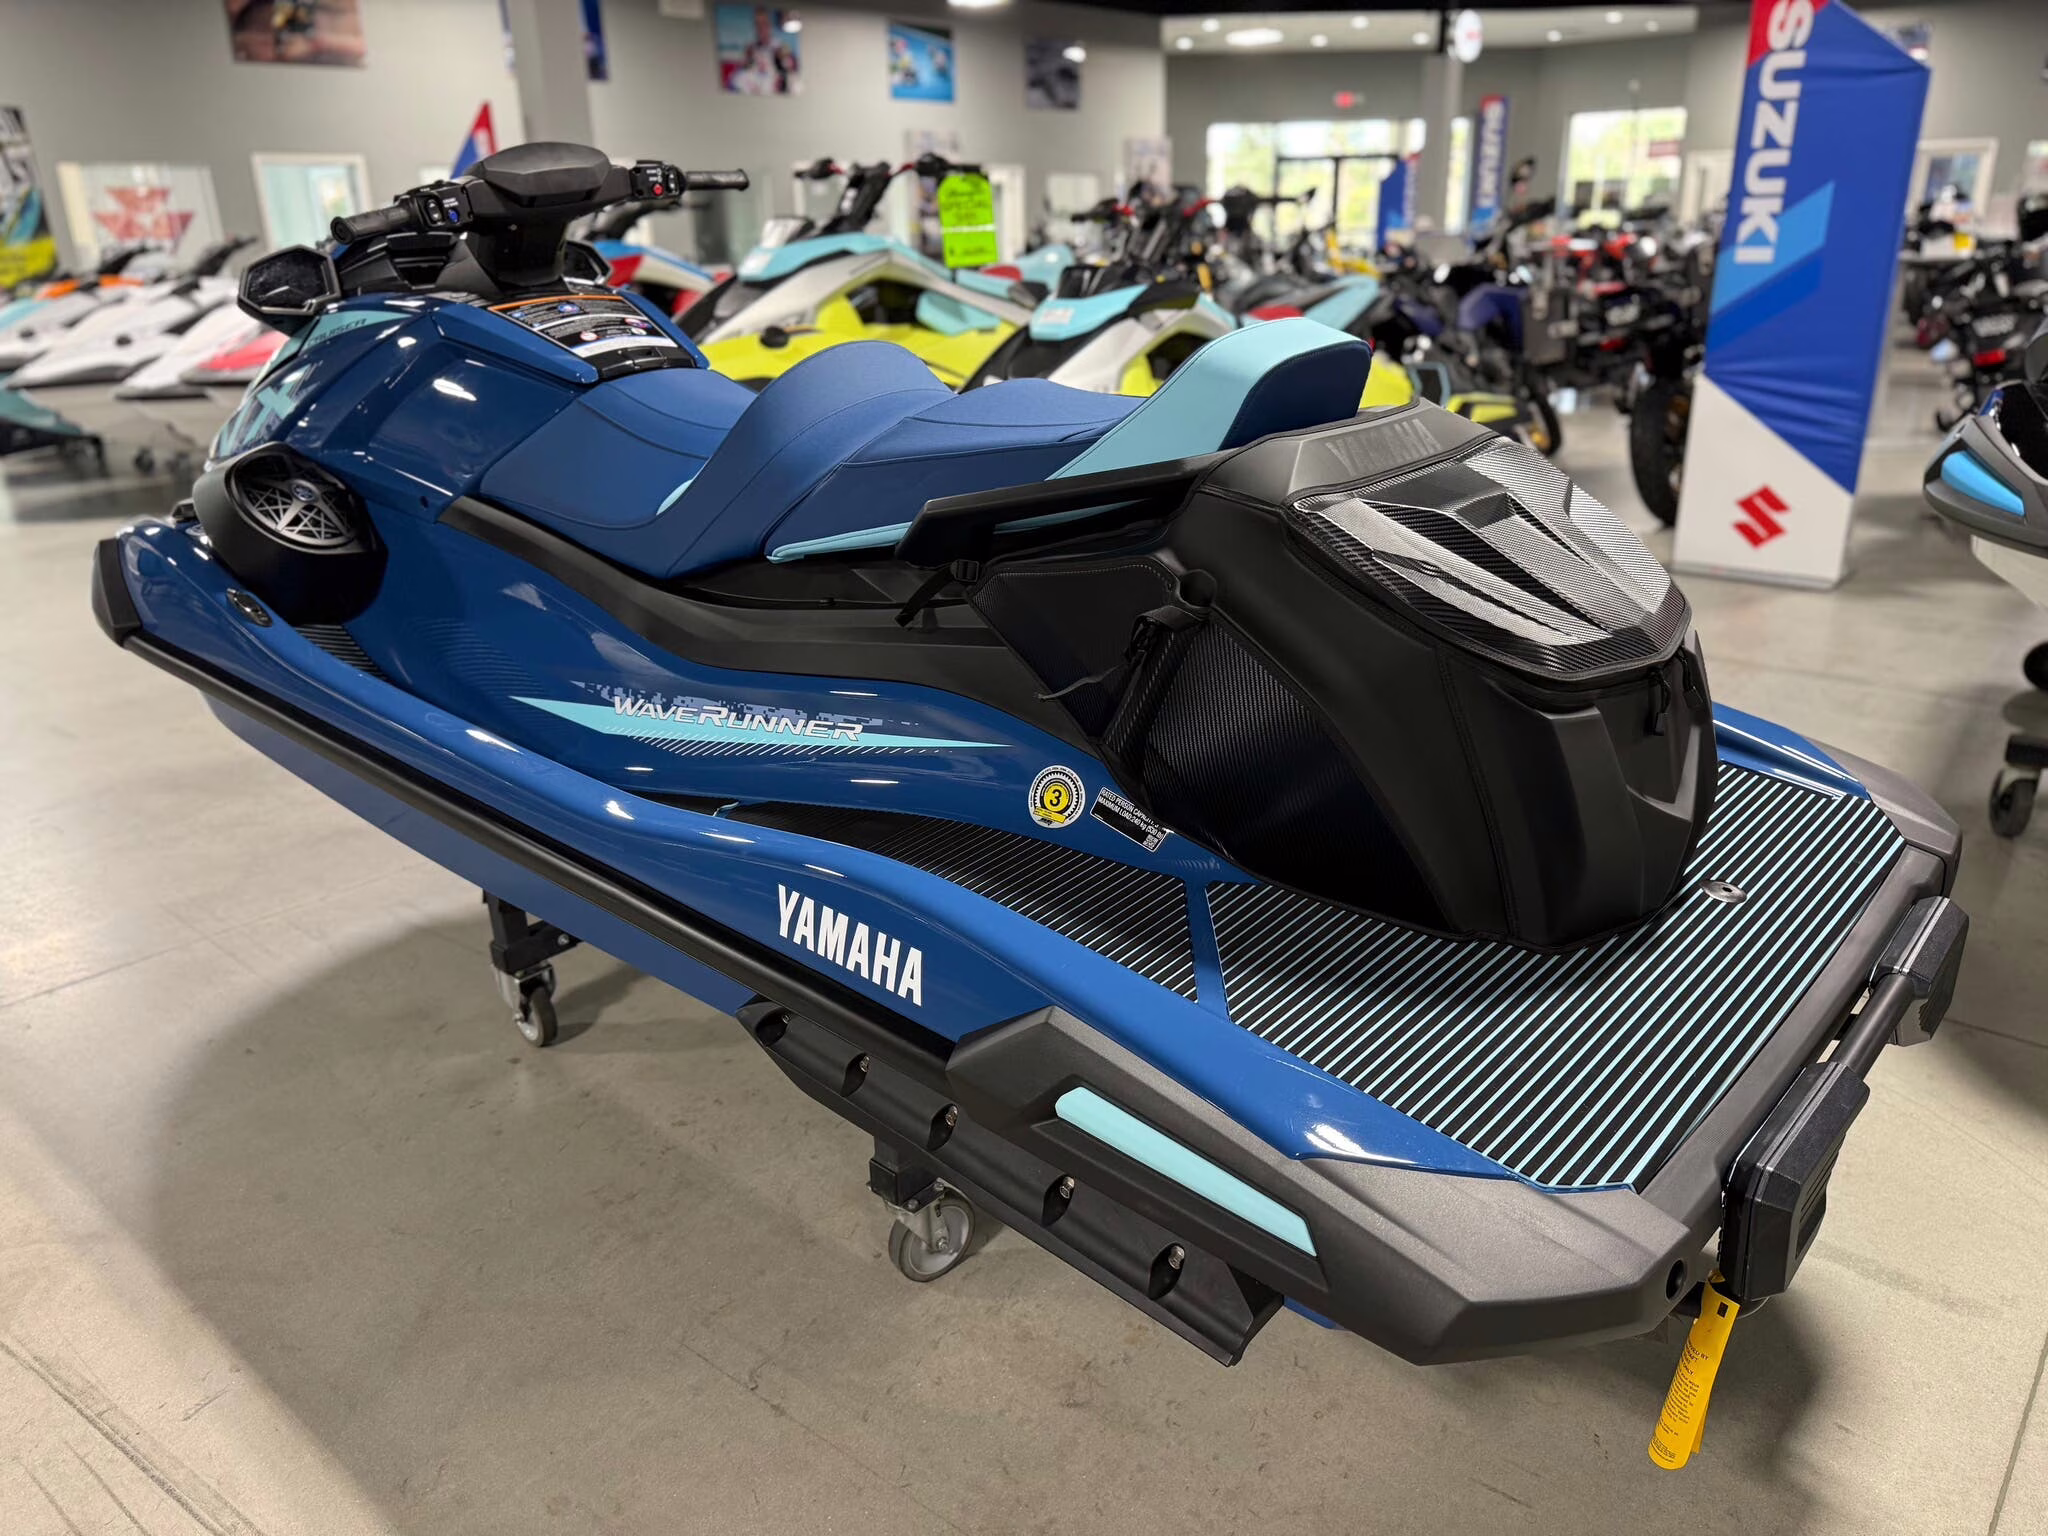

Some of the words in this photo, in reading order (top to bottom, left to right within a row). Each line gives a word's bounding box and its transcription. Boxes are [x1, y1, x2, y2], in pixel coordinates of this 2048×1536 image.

[1734, 0, 1814, 264] SUZUKI
[1050, 789, 1062, 806] 3
[1098, 796, 1120, 813] MAXIMUM
[1101, 789, 1116, 802] RATED
[1115, 798, 1135, 813] PERSON
[778, 884, 922, 1007] YAMAHA
